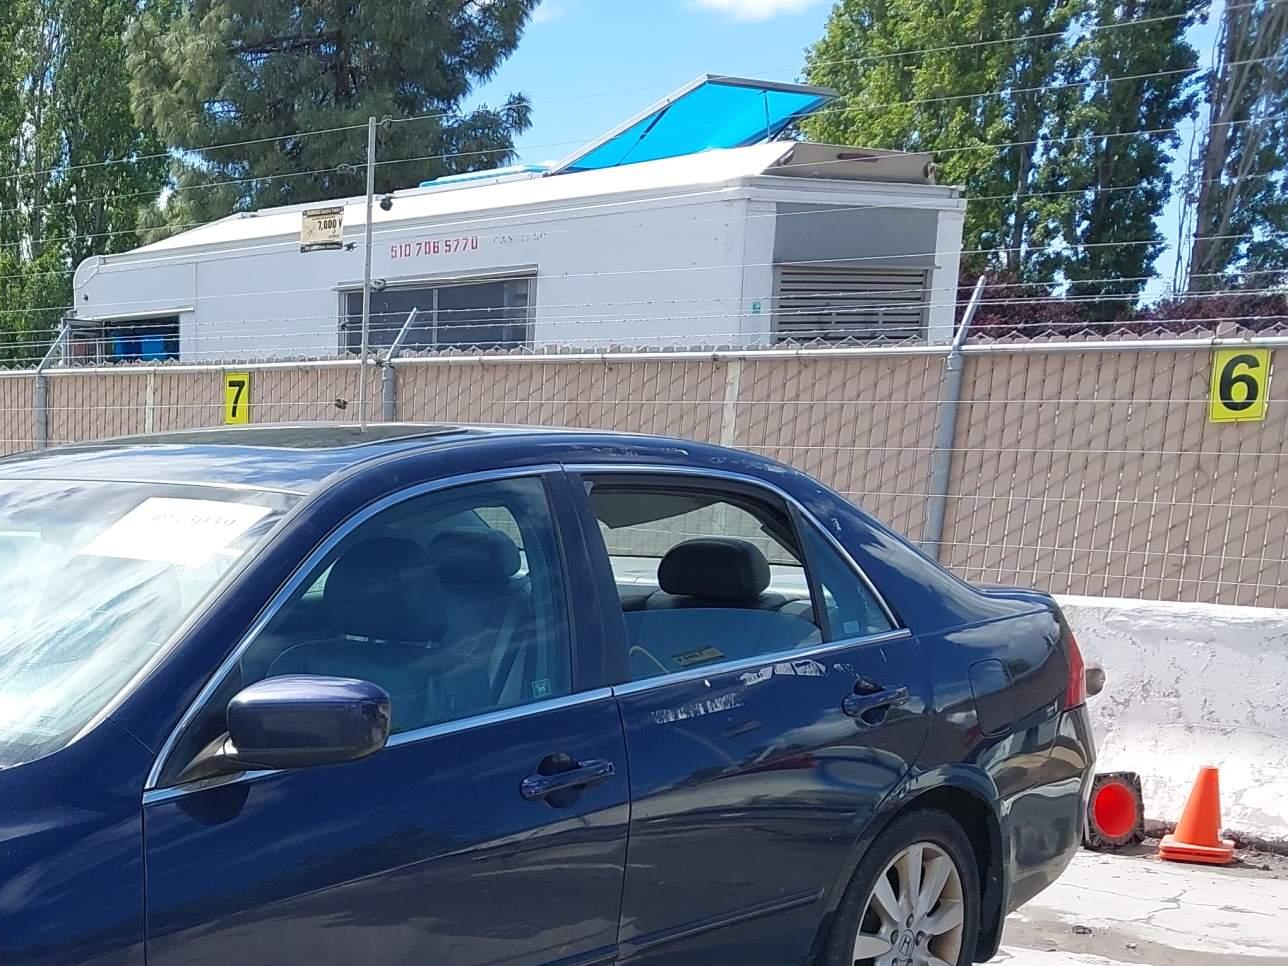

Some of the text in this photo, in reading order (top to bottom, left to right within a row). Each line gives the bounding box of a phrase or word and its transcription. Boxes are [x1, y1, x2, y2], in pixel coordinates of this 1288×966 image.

[317, 217, 343, 232] 7,000 V
[390, 242, 411, 260] 510
[415, 240, 440, 257] 706
[444, 236, 479, 254] 5770
[1219, 353, 1261, 412] 6
[228, 380, 246, 418] 7
